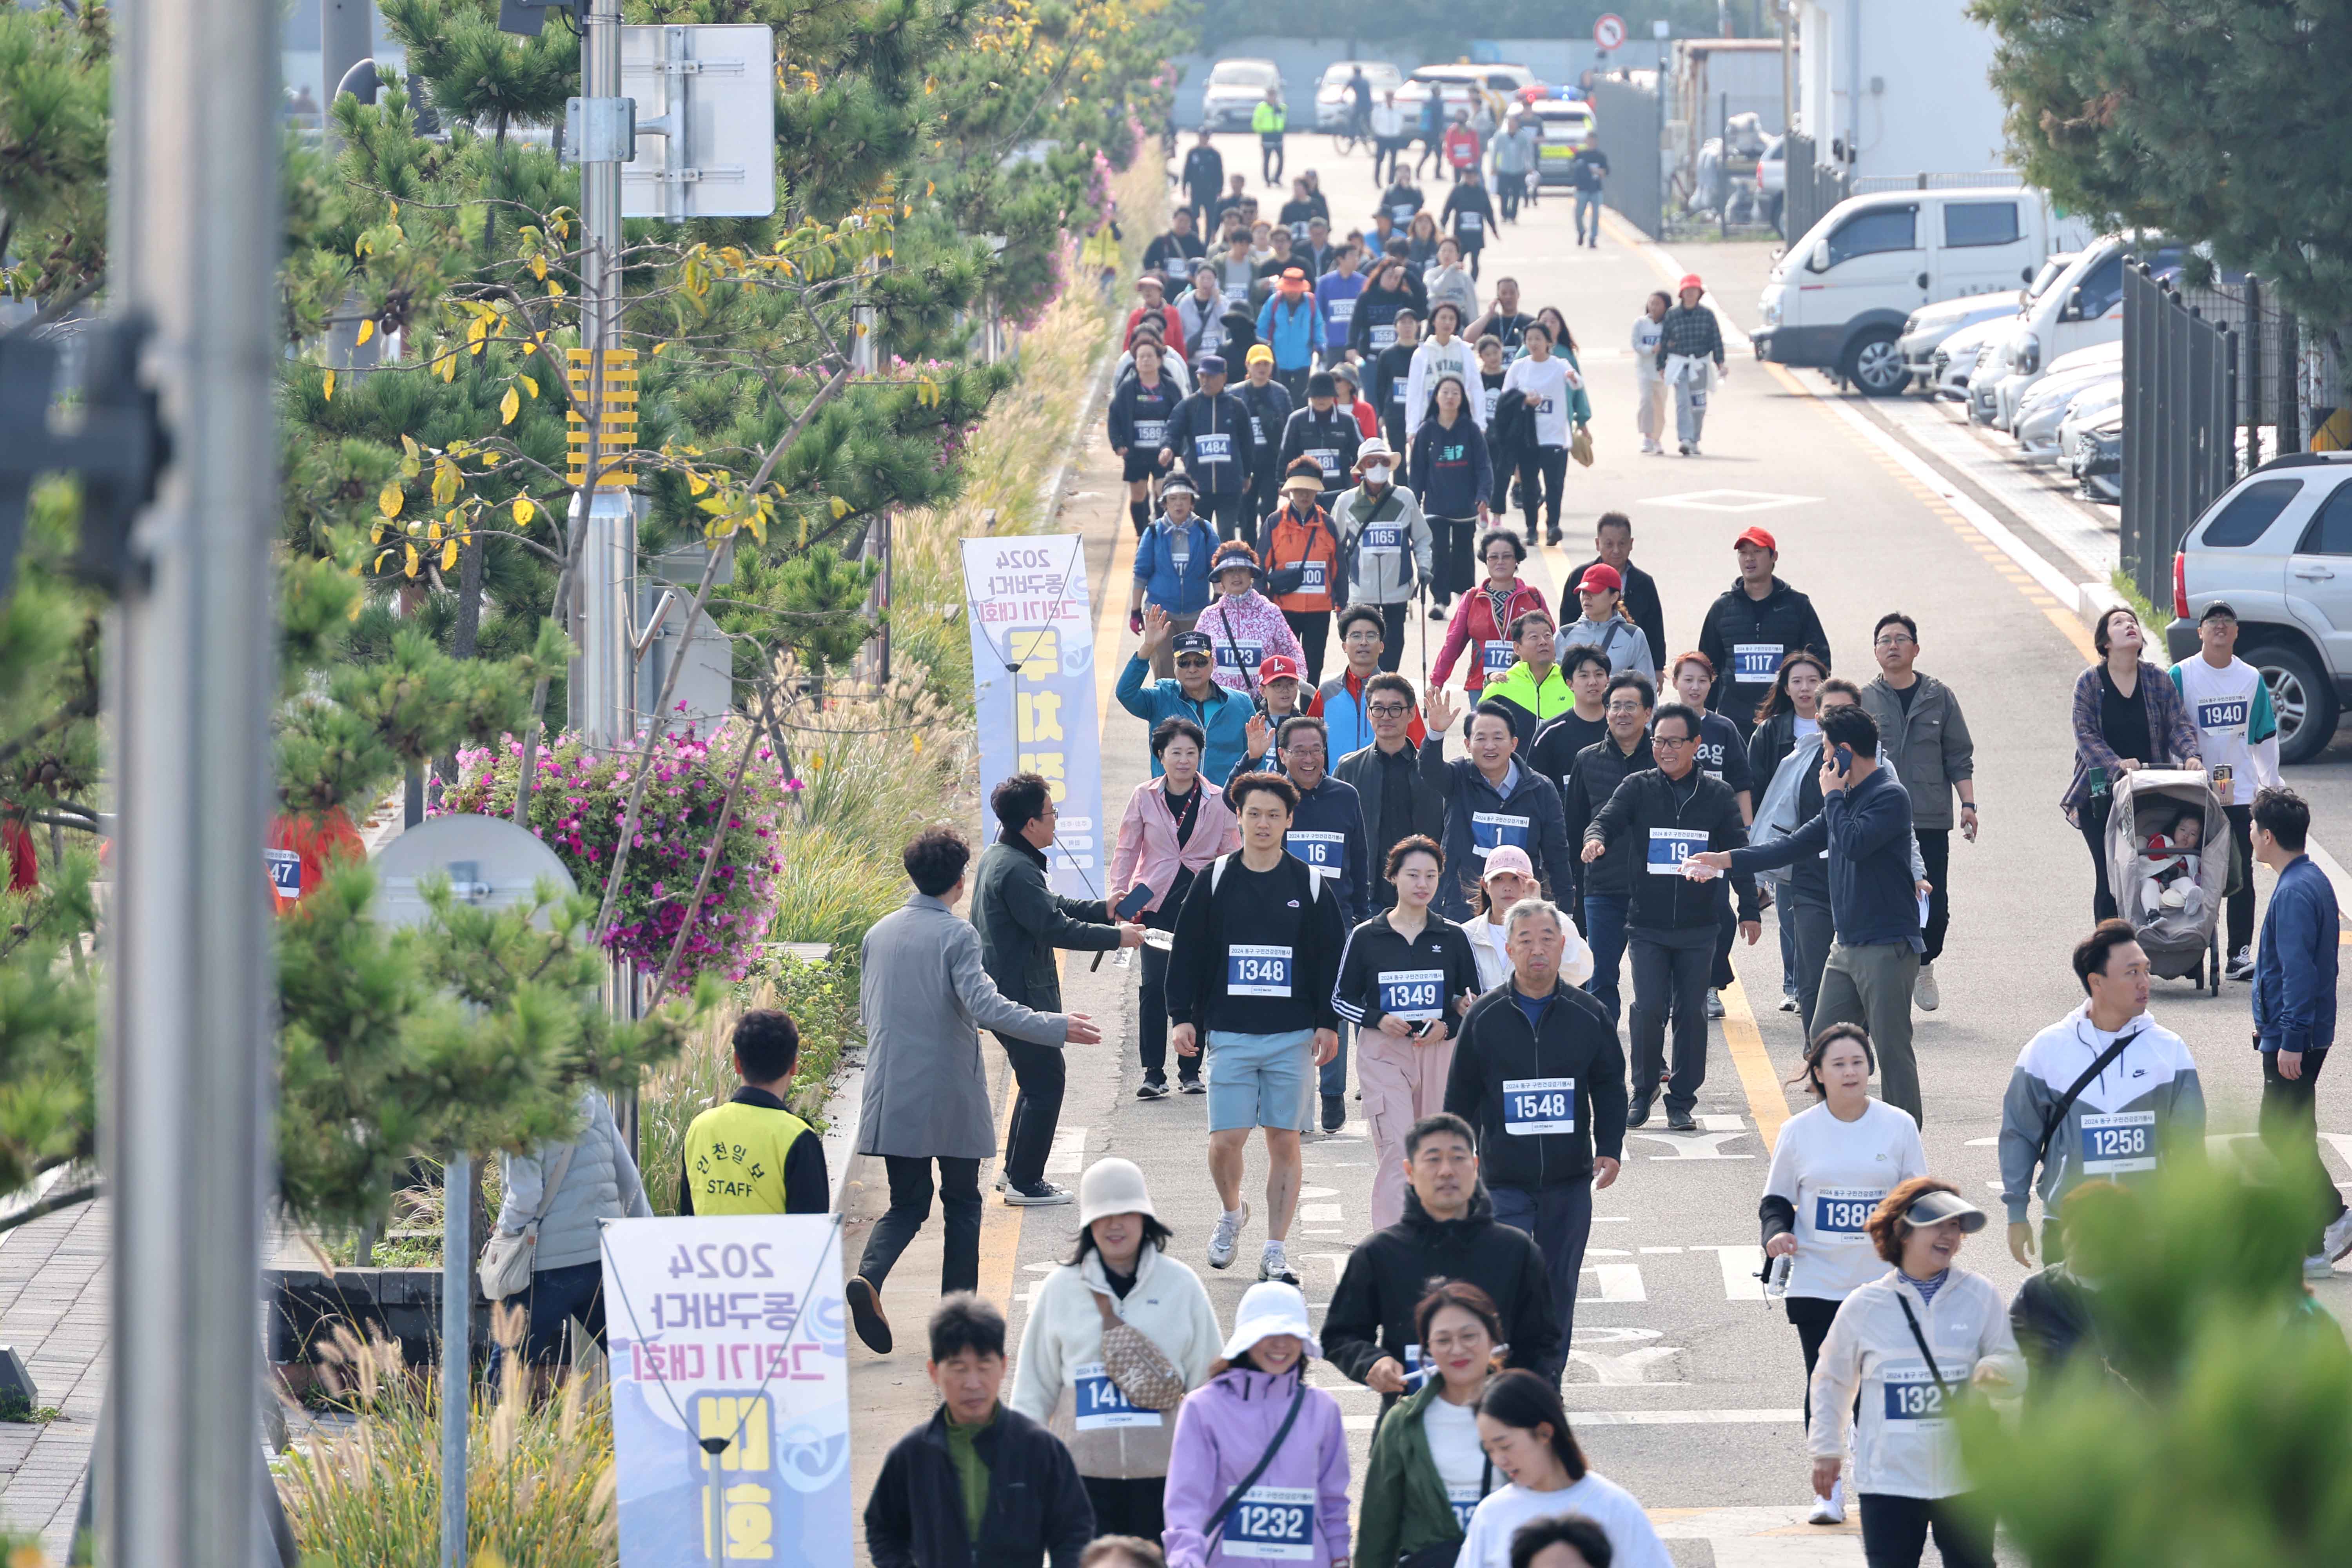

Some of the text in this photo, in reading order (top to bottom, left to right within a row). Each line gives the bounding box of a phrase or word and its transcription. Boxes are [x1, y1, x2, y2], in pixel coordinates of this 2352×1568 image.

[1535, 401, 1549, 412] 24
[1201, 441, 1227, 454] 1484
[1369, 530, 1395, 544] 1165
[1302, 570, 1321, 583] 00
[1491, 650, 1513, 665] 175
[1745, 655, 1773, 670] 1117
[2205, 705, 2241, 724] 1940
[1693, 744, 1725, 765] ag
[1496, 828, 1502, 845] 1
[1308, 844, 1326, 862] 16
[1670, 842, 1688, 860] 19
[270, 863, 292, 882] 47
[1238, 959, 1284, 981] 1348
[1389, 984, 1436, 1007] 1349
[1515, 1094, 1565, 1118] 1548
[2094, 1128, 2145, 1156] 1258
[697, 1142, 764, 1182] 인천일보
[707, 1179, 753, 1197] STAFF
[1919, 1369, 1965, 1378] 구민걷기행사
[1089, 1381, 1127, 1408] 141
[1240, 1505, 1304, 1538] 1232
